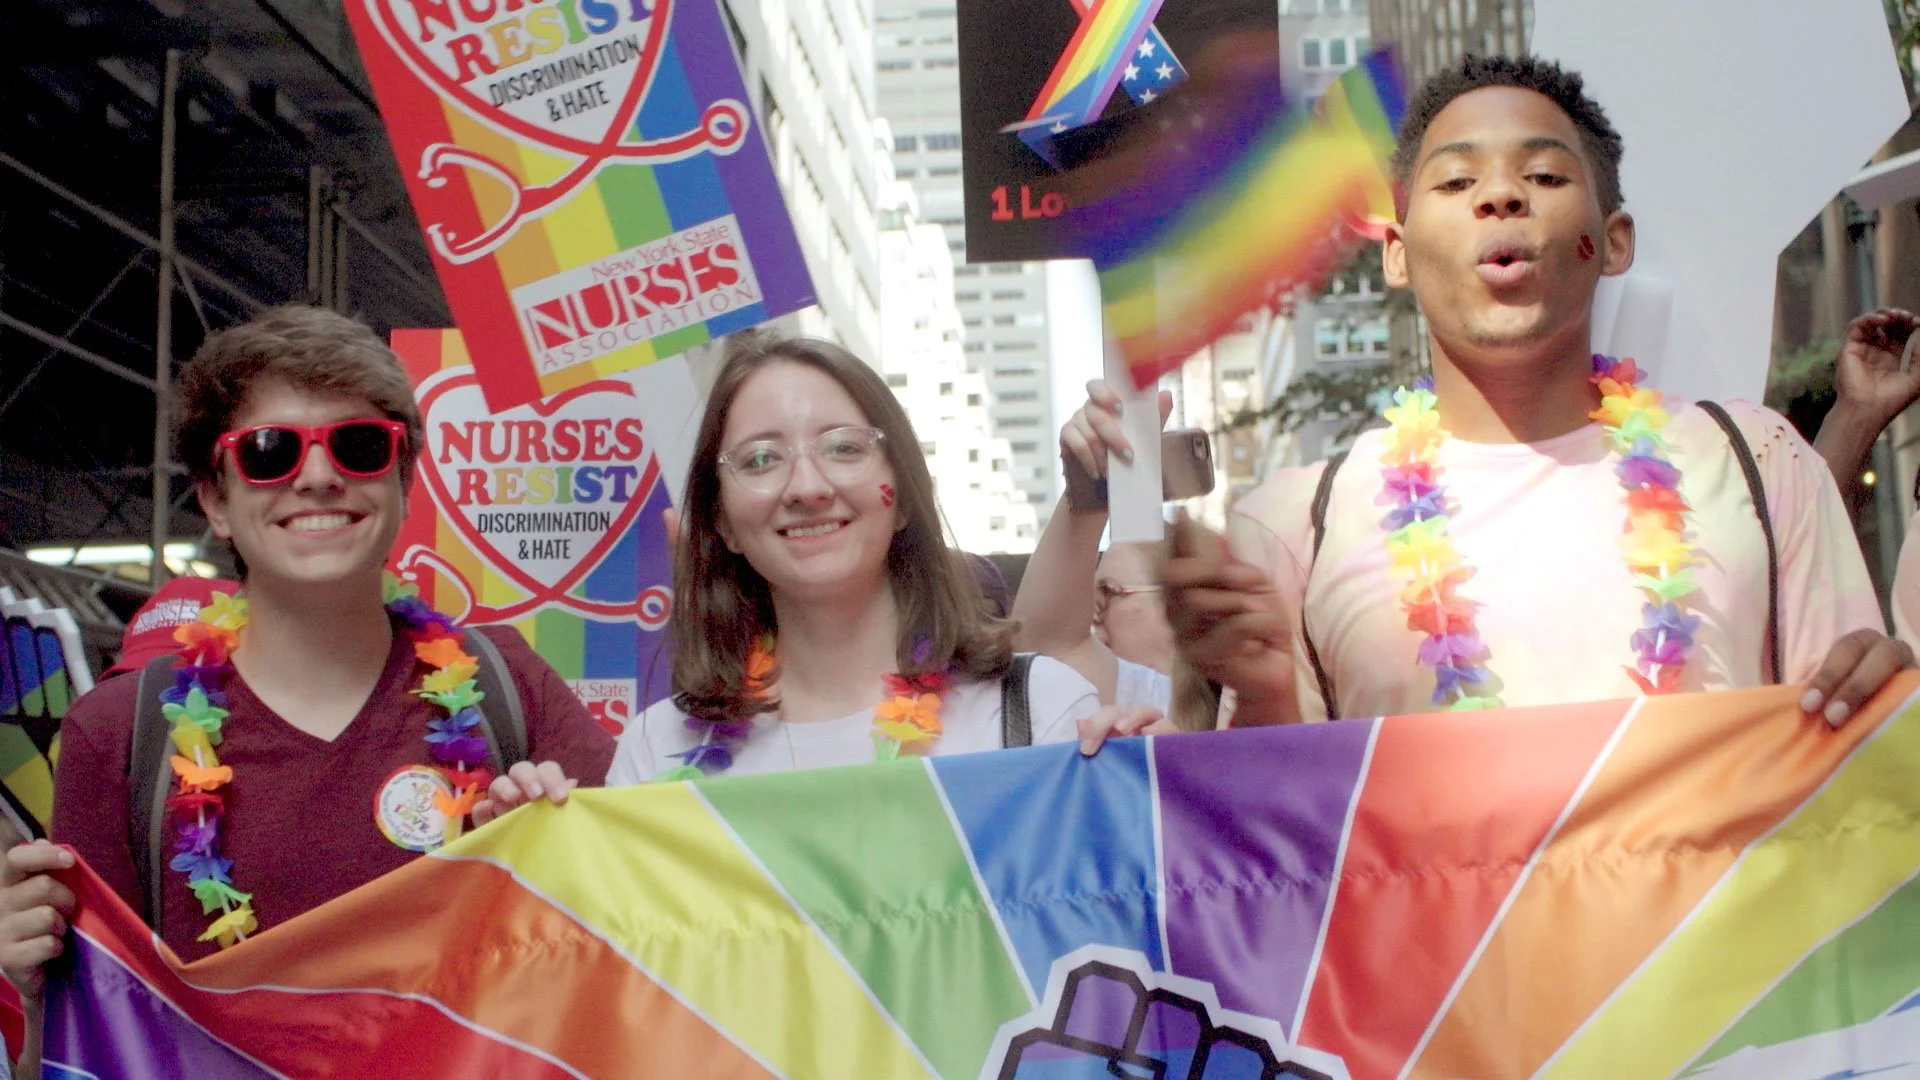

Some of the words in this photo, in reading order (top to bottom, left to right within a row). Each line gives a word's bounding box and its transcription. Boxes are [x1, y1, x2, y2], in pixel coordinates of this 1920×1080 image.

[489, 34, 642, 108] DISCRIMINATION
[546, 98, 564, 122] &
[563, 81, 610, 118] HATE
[991, 185, 1014, 220] 1
[1021, 184, 1066, 219] Lo
[590, 256, 635, 282] New
[637, 237, 681, 265] York
[682, 224, 729, 251] State
[524, 241, 742, 353] NURSES
[542, 284, 757, 371] ASSOCIATION
[438, 418, 643, 464] NURSES
[457, 465, 638, 506] RESIST
[477, 511, 610, 534] DISCRIMINATION
[518, 541, 529, 560] &
[532, 540, 571, 560] HATE
[589, 682, 628, 697] State
